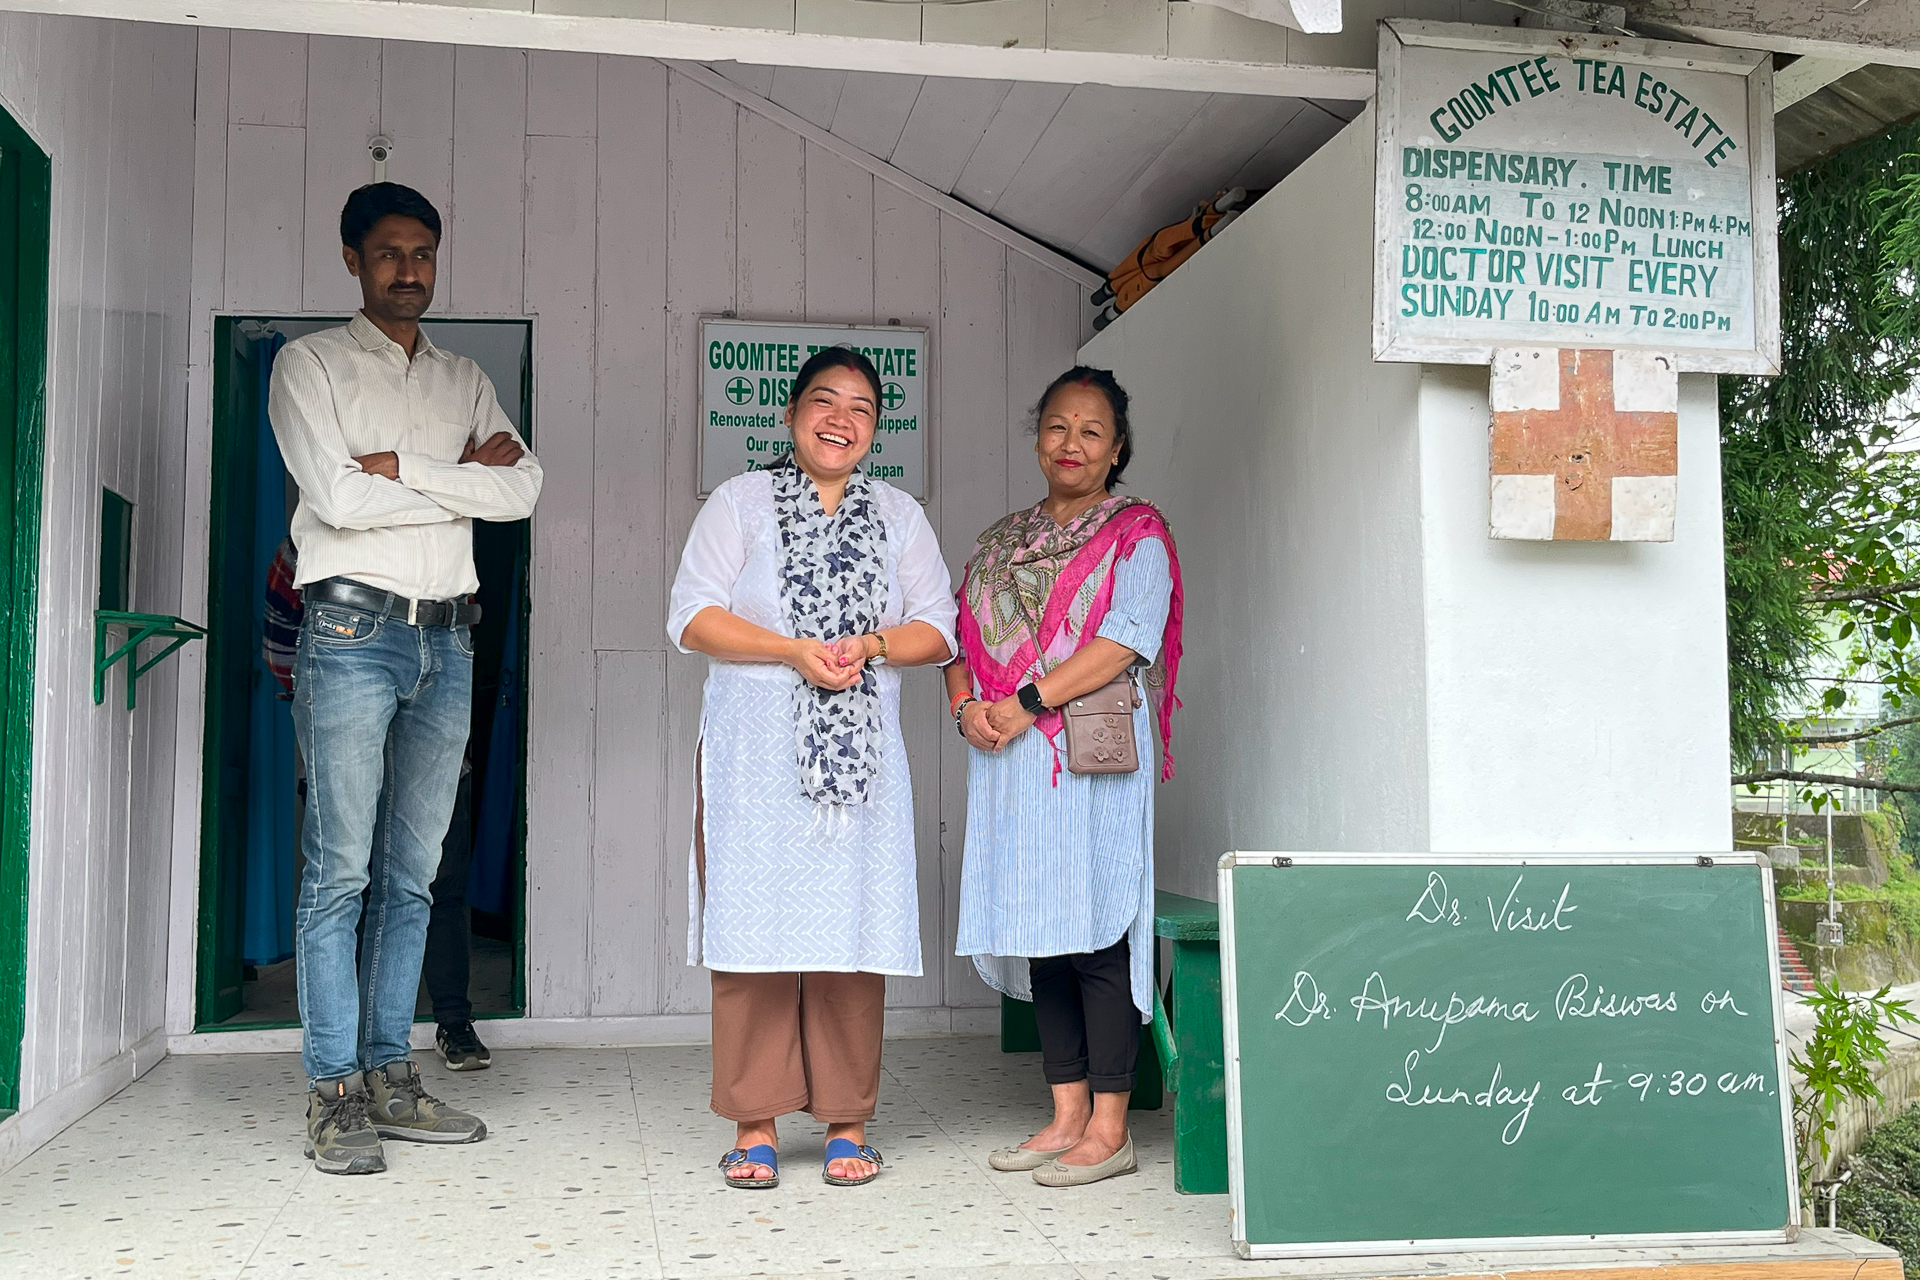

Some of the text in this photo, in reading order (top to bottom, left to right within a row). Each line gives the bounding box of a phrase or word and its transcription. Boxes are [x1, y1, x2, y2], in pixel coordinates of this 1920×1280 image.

[1429, 55, 1737, 169] GOOMTEE TEA ESTATE
[1602, 161, 1673, 195] TIME
[1412, 218, 1467, 241] 12:00
[1568, 202, 1590, 224] 12
[1402, 244, 1719, 298] DOCTOR VISIT EVERY
[1401, 283, 1514, 320] SUNDAY
[1528, 290, 1580, 323] 10:00
[709, 340, 799, 373] GOOMTEE
[709, 410, 776, 428] Renovated
[877, 414, 917, 434] uipped
[746, 435, 769, 452] Our
[866, 461, 904, 481] Japan
[1405, 870, 1578, 932] Dr. Visit
[1274, 970, 1749, 1054] Dr. Anupama Biswas on
[1385, 1049, 1537, 1146] Sunday
[1560, 1061, 1613, 1107] at
[1627, 1070, 1707, 1103] 9:30
